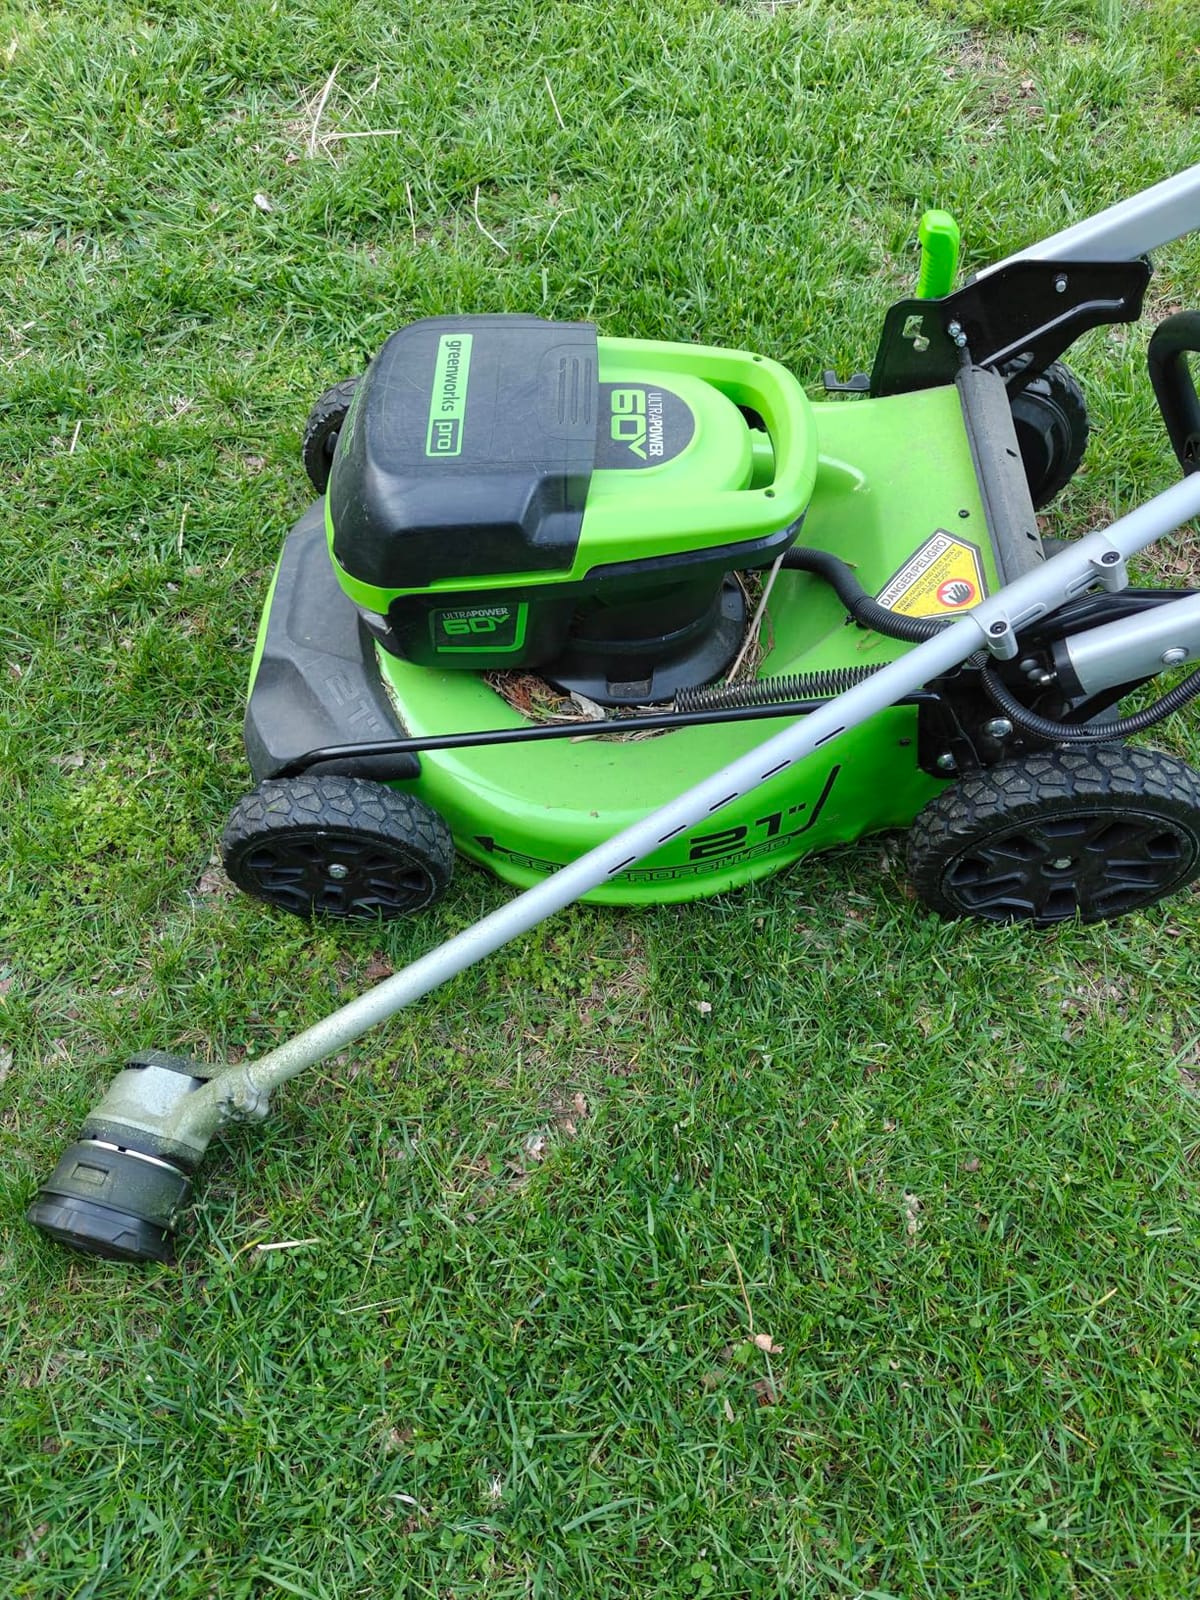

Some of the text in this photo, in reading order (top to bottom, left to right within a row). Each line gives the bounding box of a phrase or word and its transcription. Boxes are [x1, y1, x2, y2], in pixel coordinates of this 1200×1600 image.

[435, 340, 461, 450] greenworks pro
[611, 389, 647, 460] 60V
[648, 392, 664, 457] ULTRAPOWER
[880, 539, 947, 607] DANGER/PELIGRO
[443, 607, 509, 619] ULTRAPOWER
[443, 614, 511, 635] 60V
[689, 803, 806, 860] 21"
